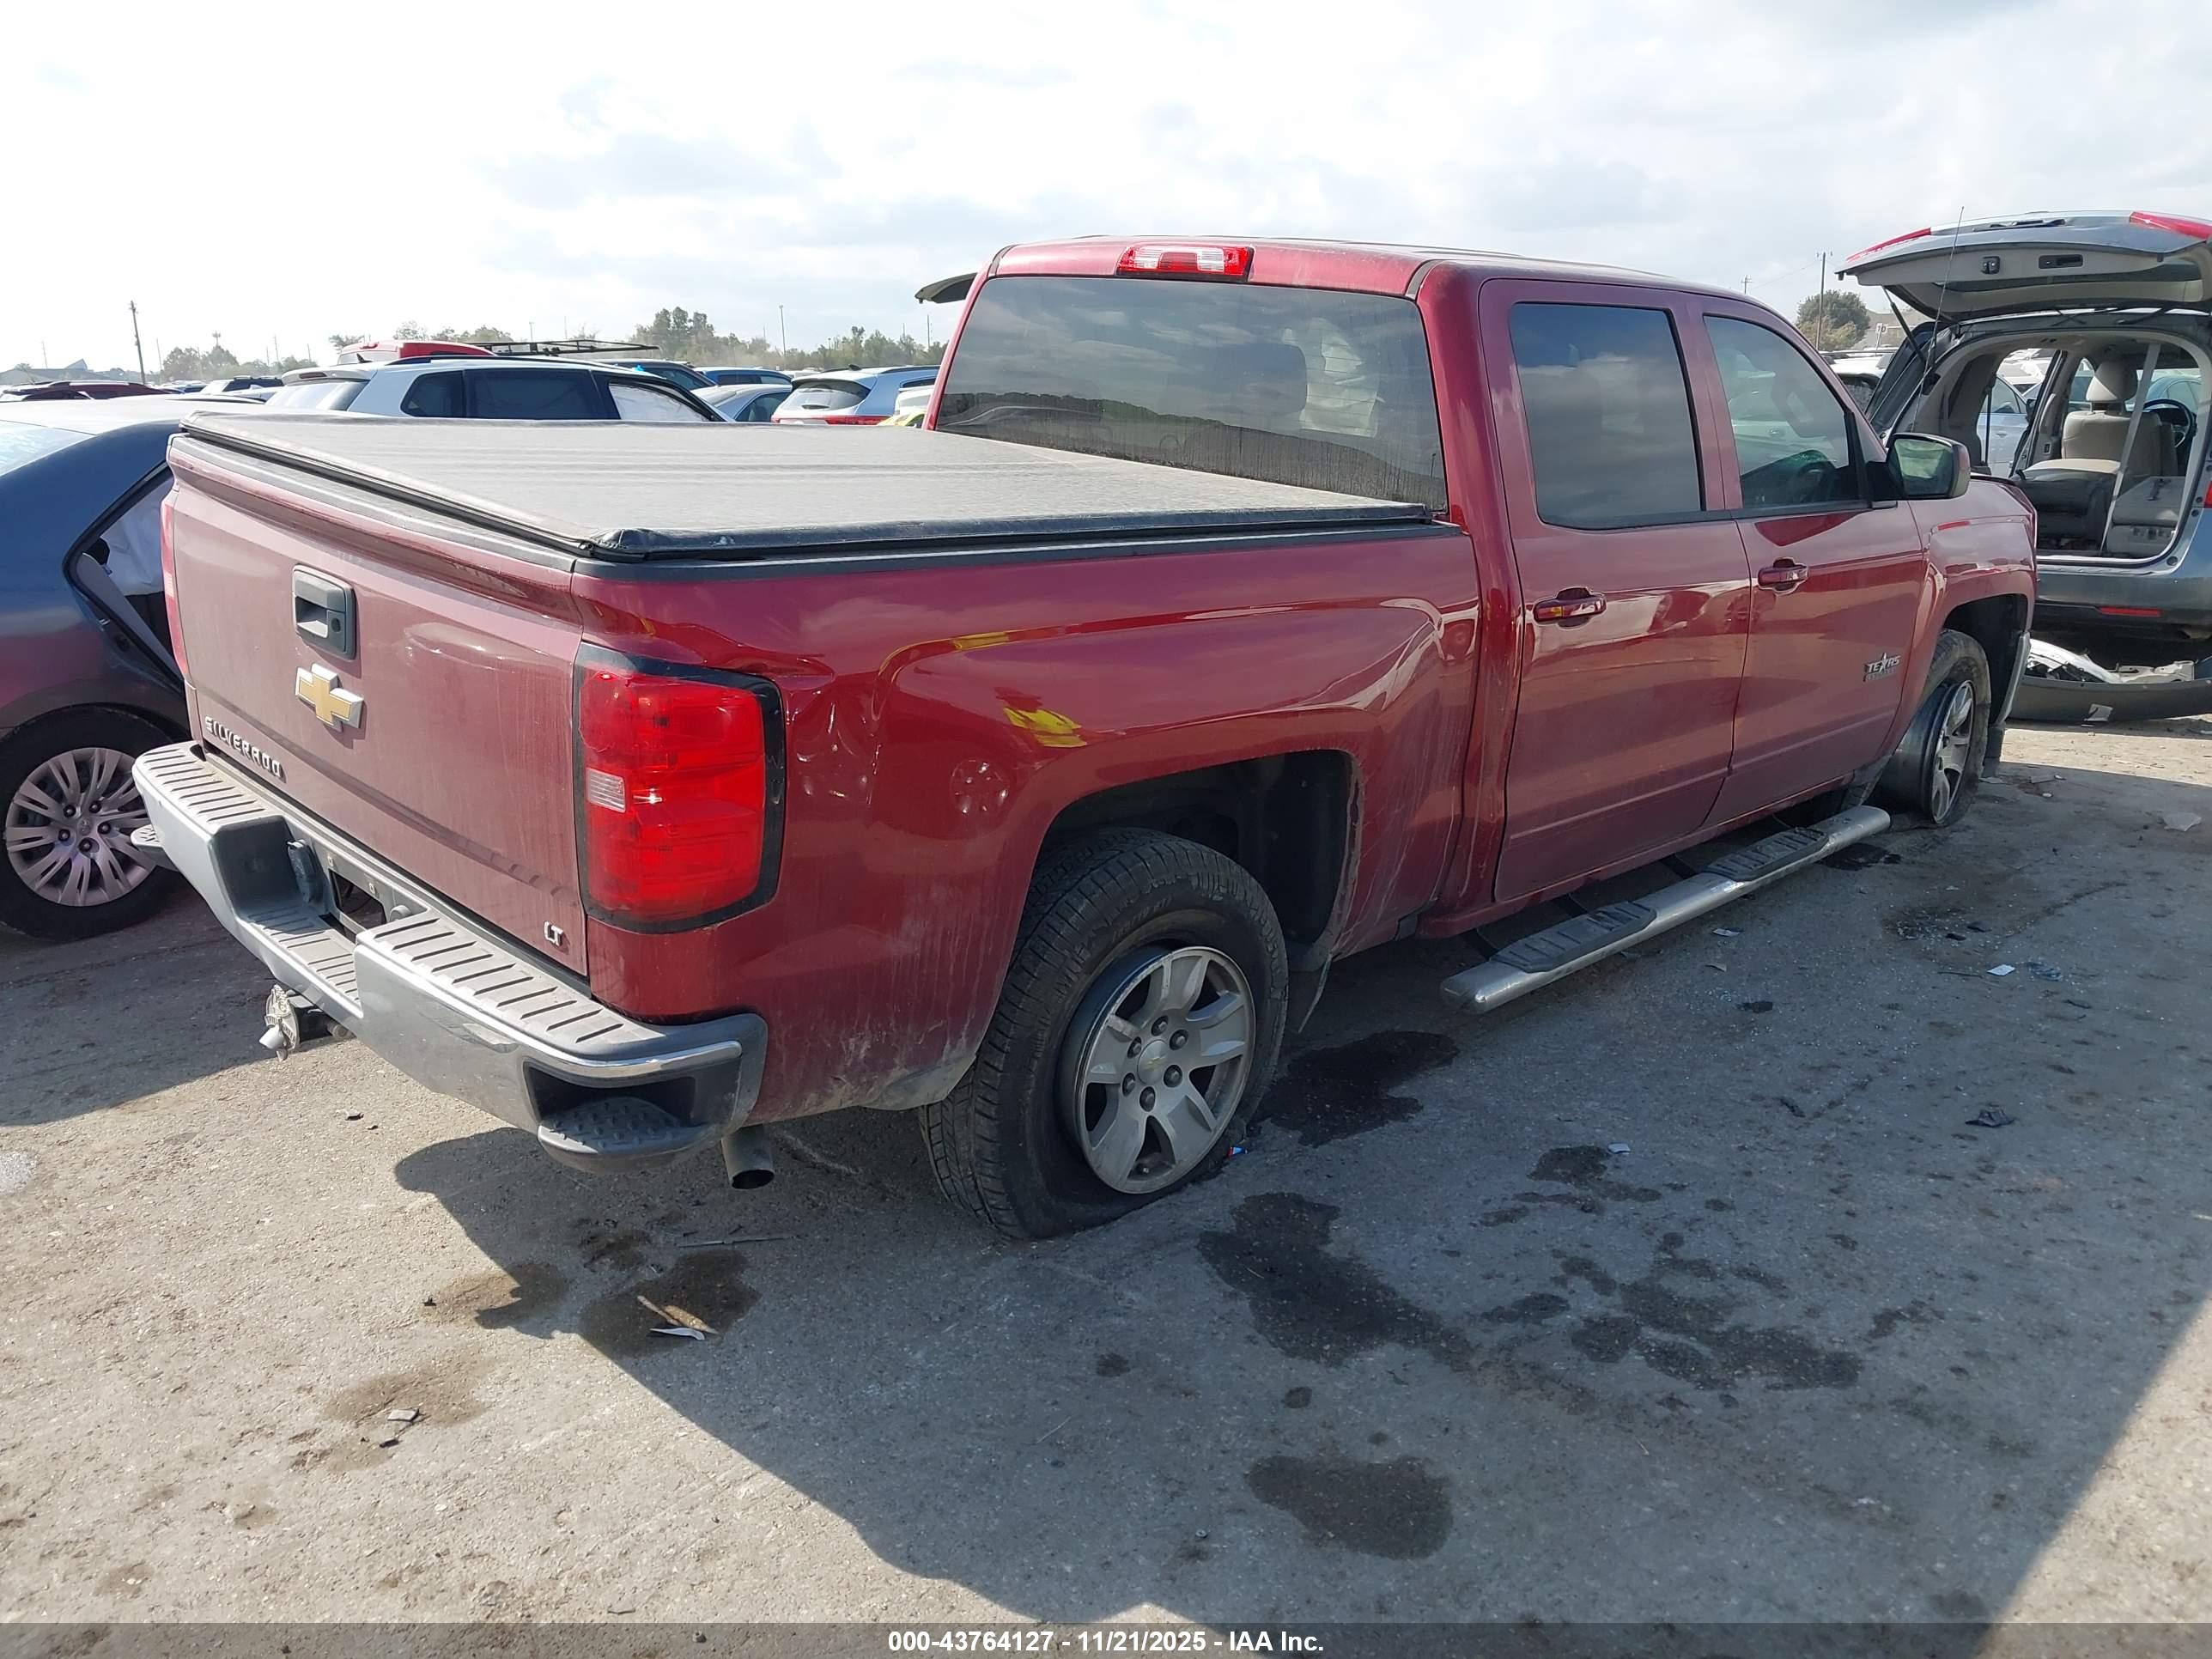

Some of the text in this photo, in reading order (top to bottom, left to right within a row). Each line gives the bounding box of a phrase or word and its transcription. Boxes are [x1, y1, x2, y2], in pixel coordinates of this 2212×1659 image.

[1866, 653, 1901, 673] TEXAS
[204, 716, 283, 778] SILVERADO
[544, 921, 564, 946] LT
